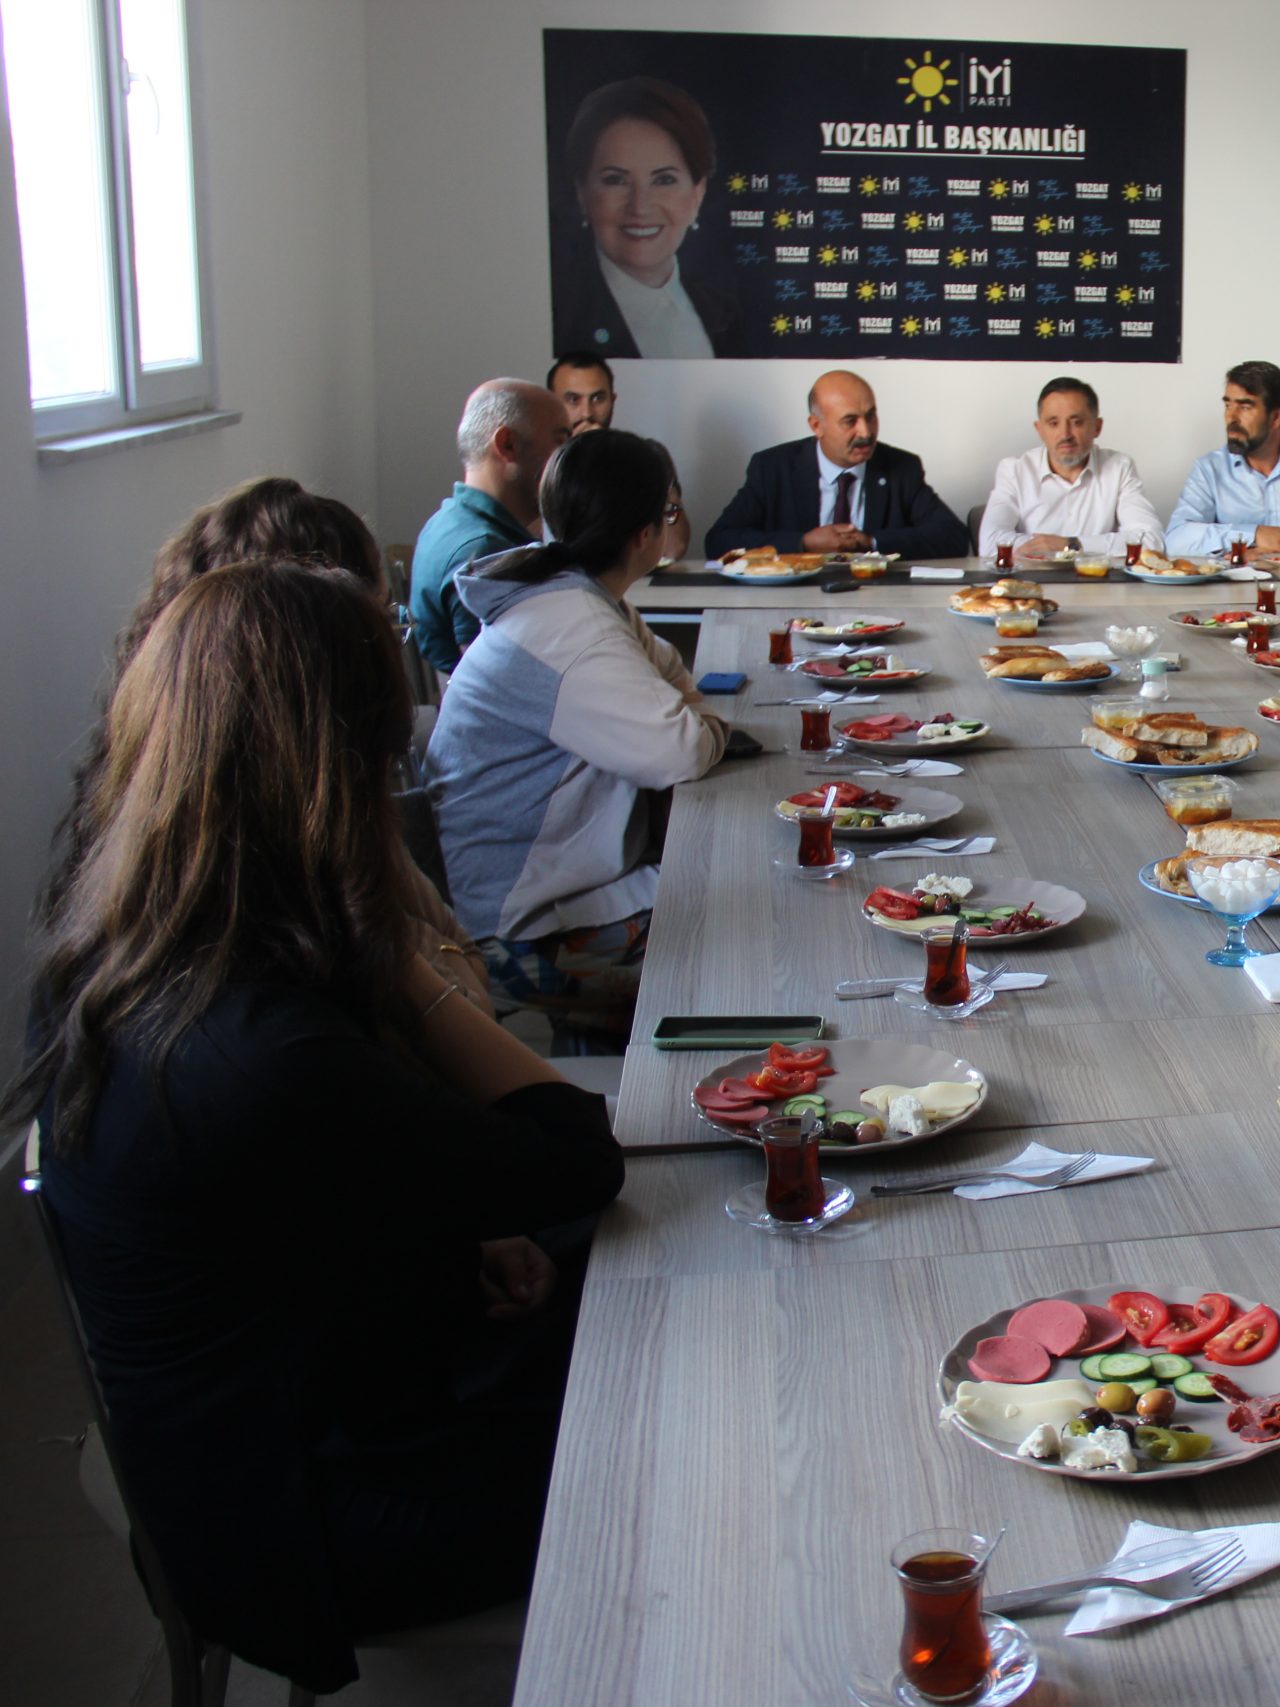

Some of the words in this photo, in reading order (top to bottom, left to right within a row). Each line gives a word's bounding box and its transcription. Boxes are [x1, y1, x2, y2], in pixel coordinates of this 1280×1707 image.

[969, 58, 1011, 95] İYİ
[969, 96, 1012, 107] PARTİ
[821, 122, 910, 148] YOZGAT
[917, 120, 938, 149] İL
[945, 123, 1086, 155] BAŞKANLIĞI
